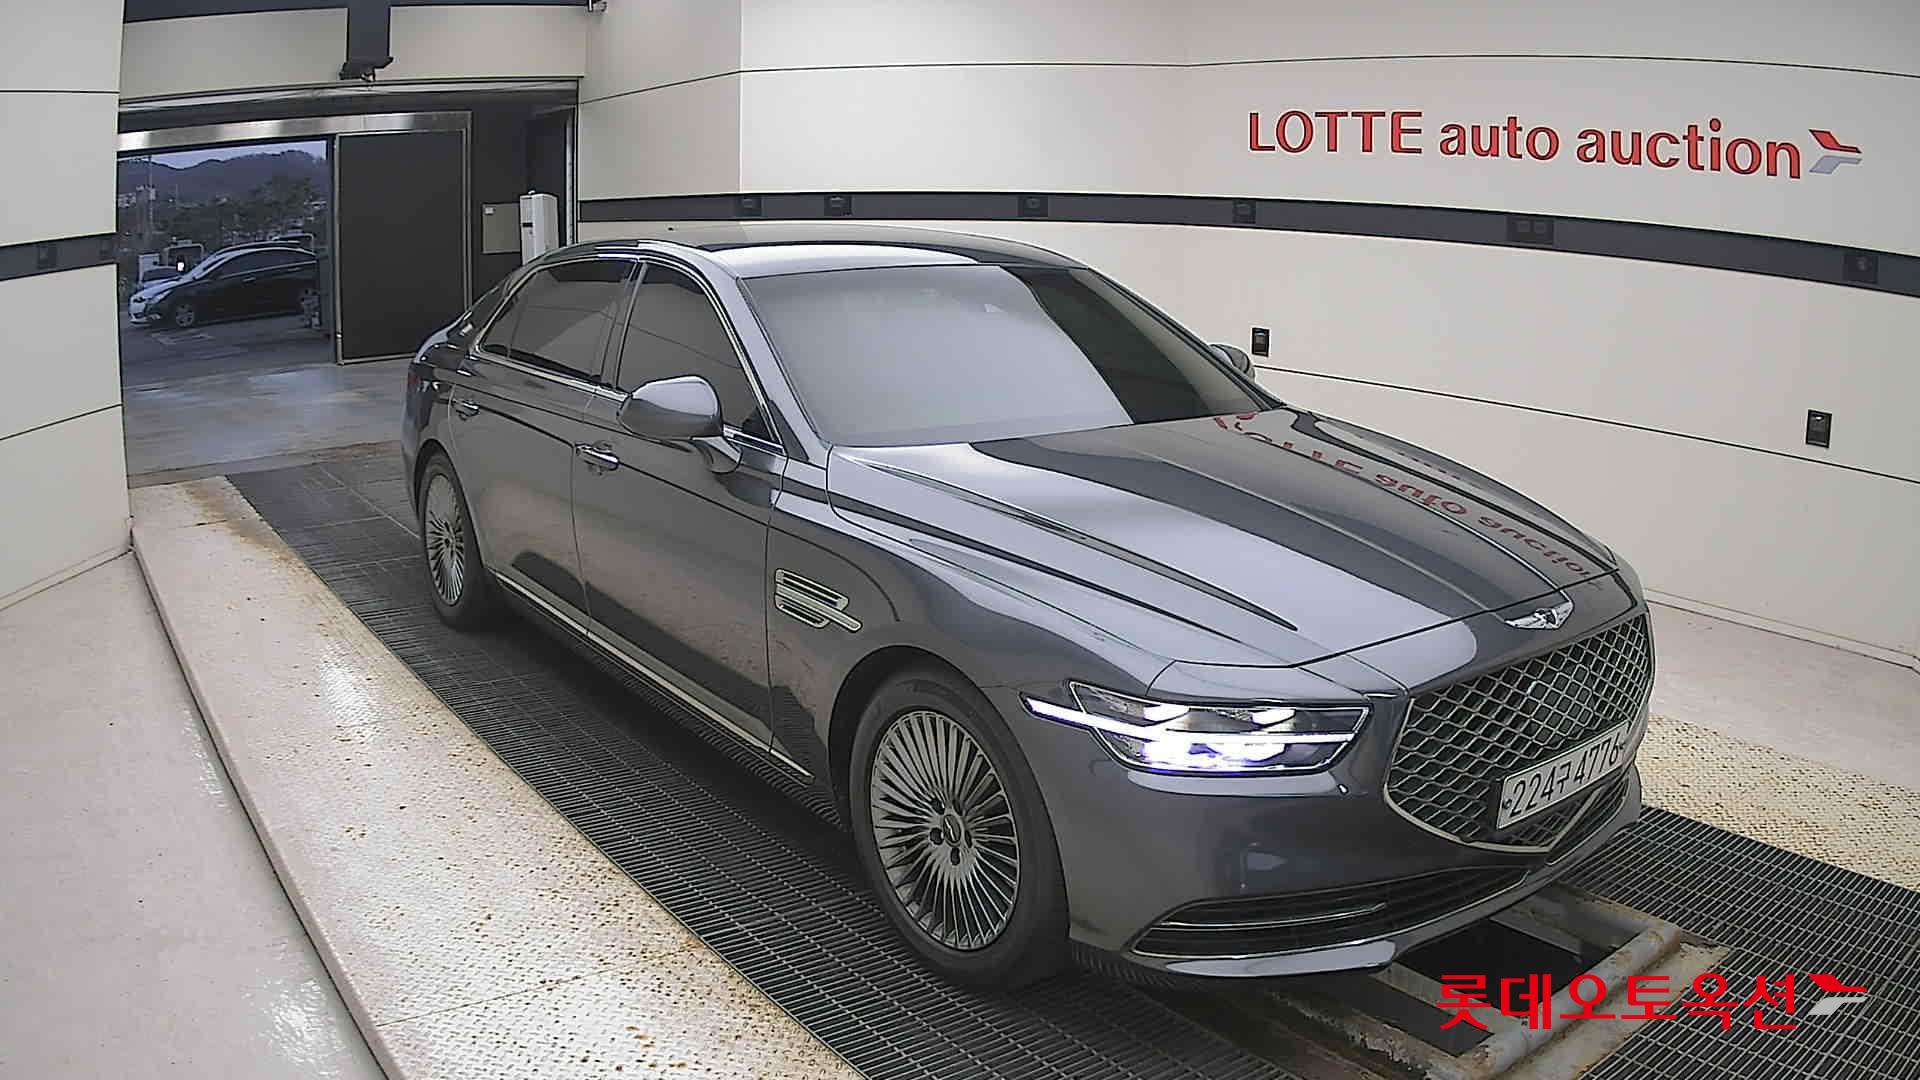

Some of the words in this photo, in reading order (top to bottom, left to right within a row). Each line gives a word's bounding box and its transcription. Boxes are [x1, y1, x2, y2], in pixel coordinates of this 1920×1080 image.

[1249, 110, 1422, 154] LOTTE
[1439, 116, 1560, 161] auto
[1576, 118, 1801, 179] auction
